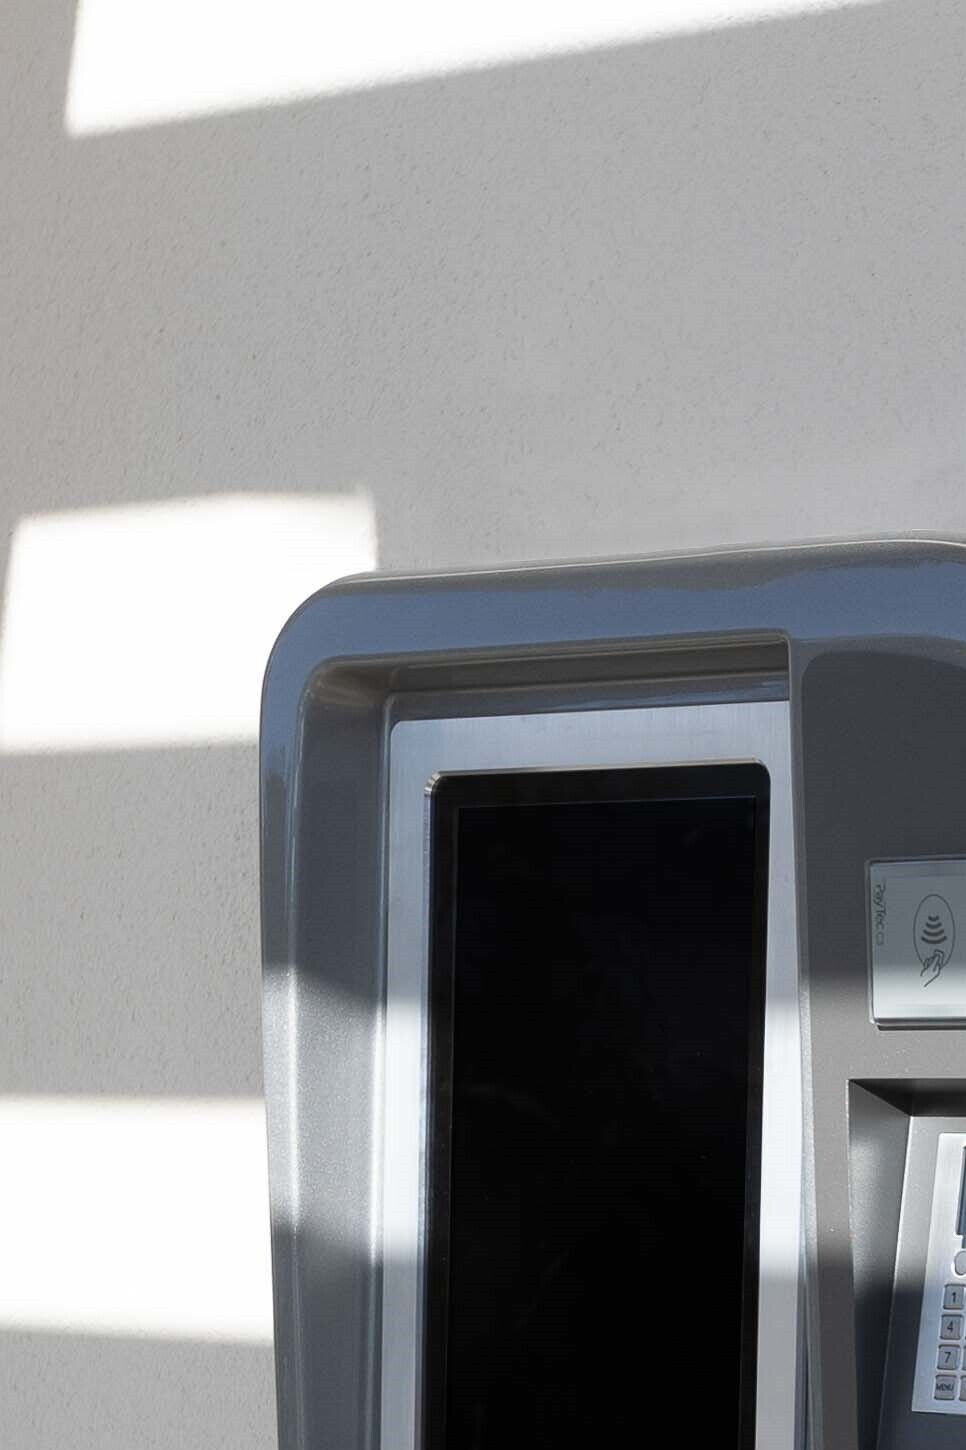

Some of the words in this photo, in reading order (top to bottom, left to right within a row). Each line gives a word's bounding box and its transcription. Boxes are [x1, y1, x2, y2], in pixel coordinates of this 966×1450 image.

[951, 1291, 957, 1304] 1
[947, 1321, 954, 1333] 4
[944, 1351, 952, 1363] 7
